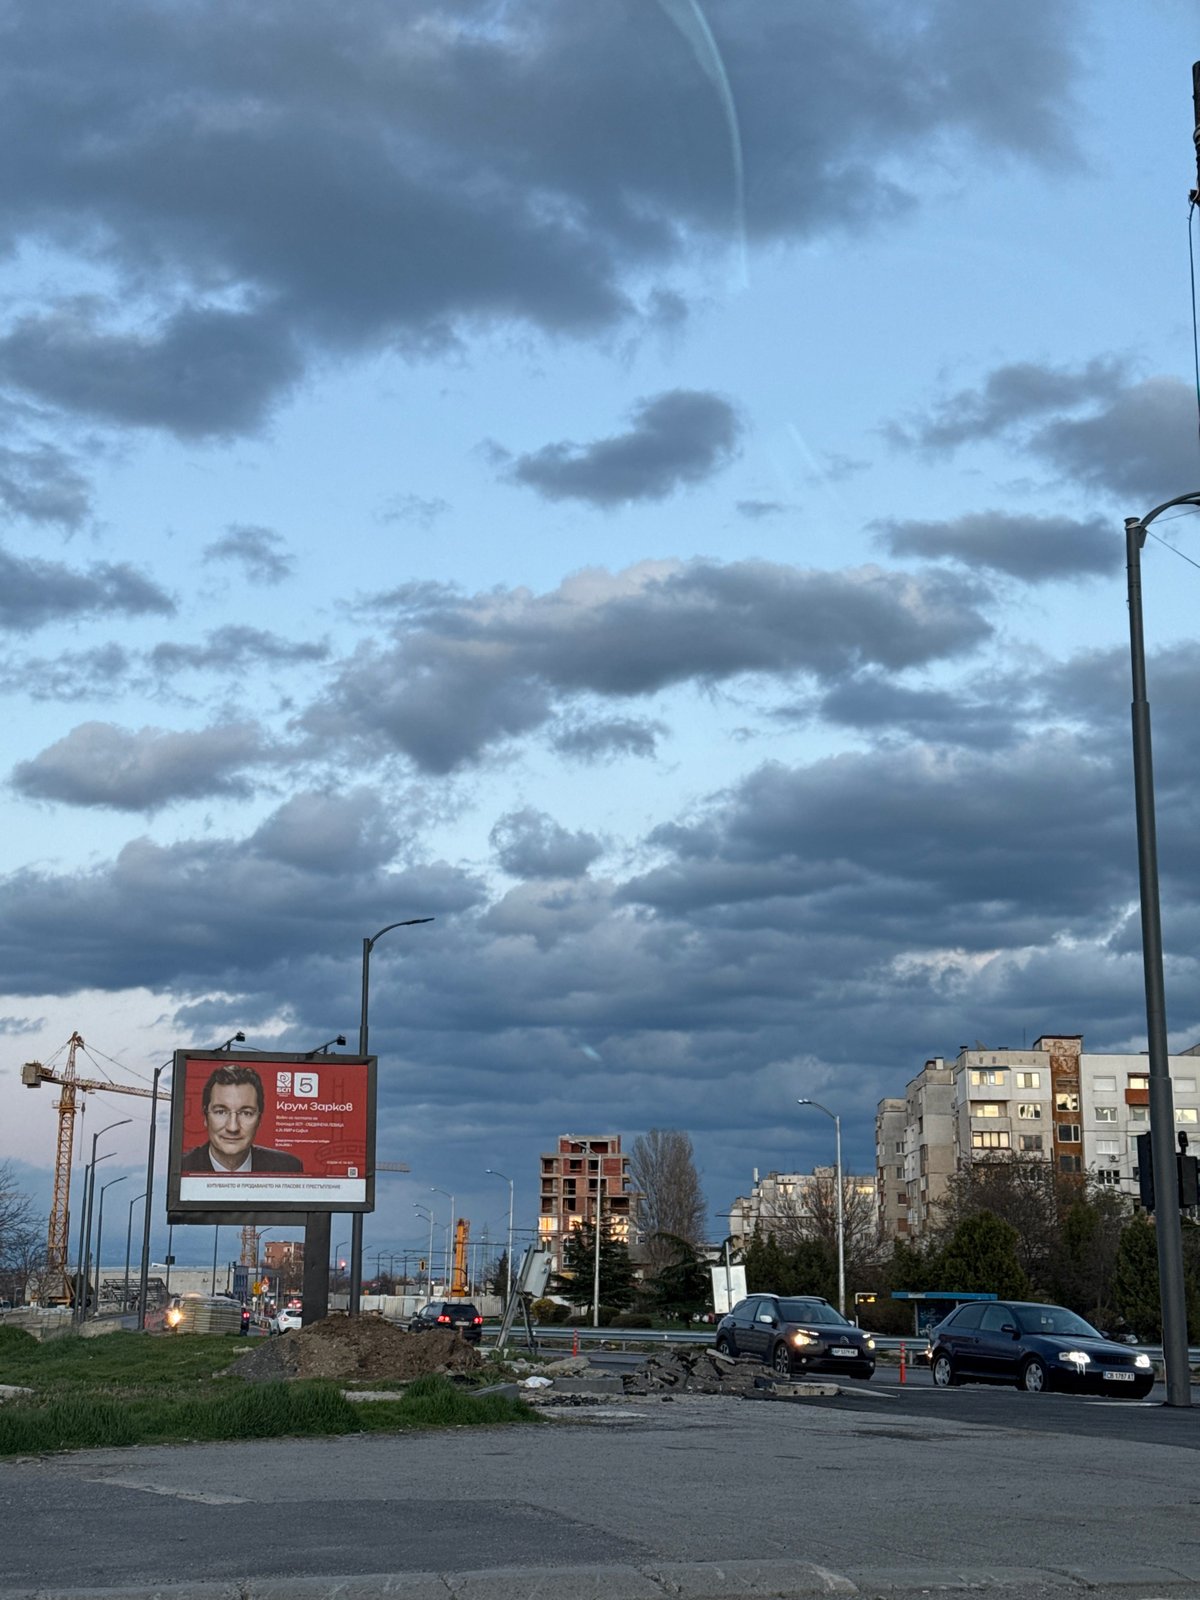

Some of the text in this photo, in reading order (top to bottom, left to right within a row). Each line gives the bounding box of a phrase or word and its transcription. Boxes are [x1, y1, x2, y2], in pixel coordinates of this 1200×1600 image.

[299, 1077, 313, 1094] 5
[276, 1101, 353, 1112] Крум Зарков
